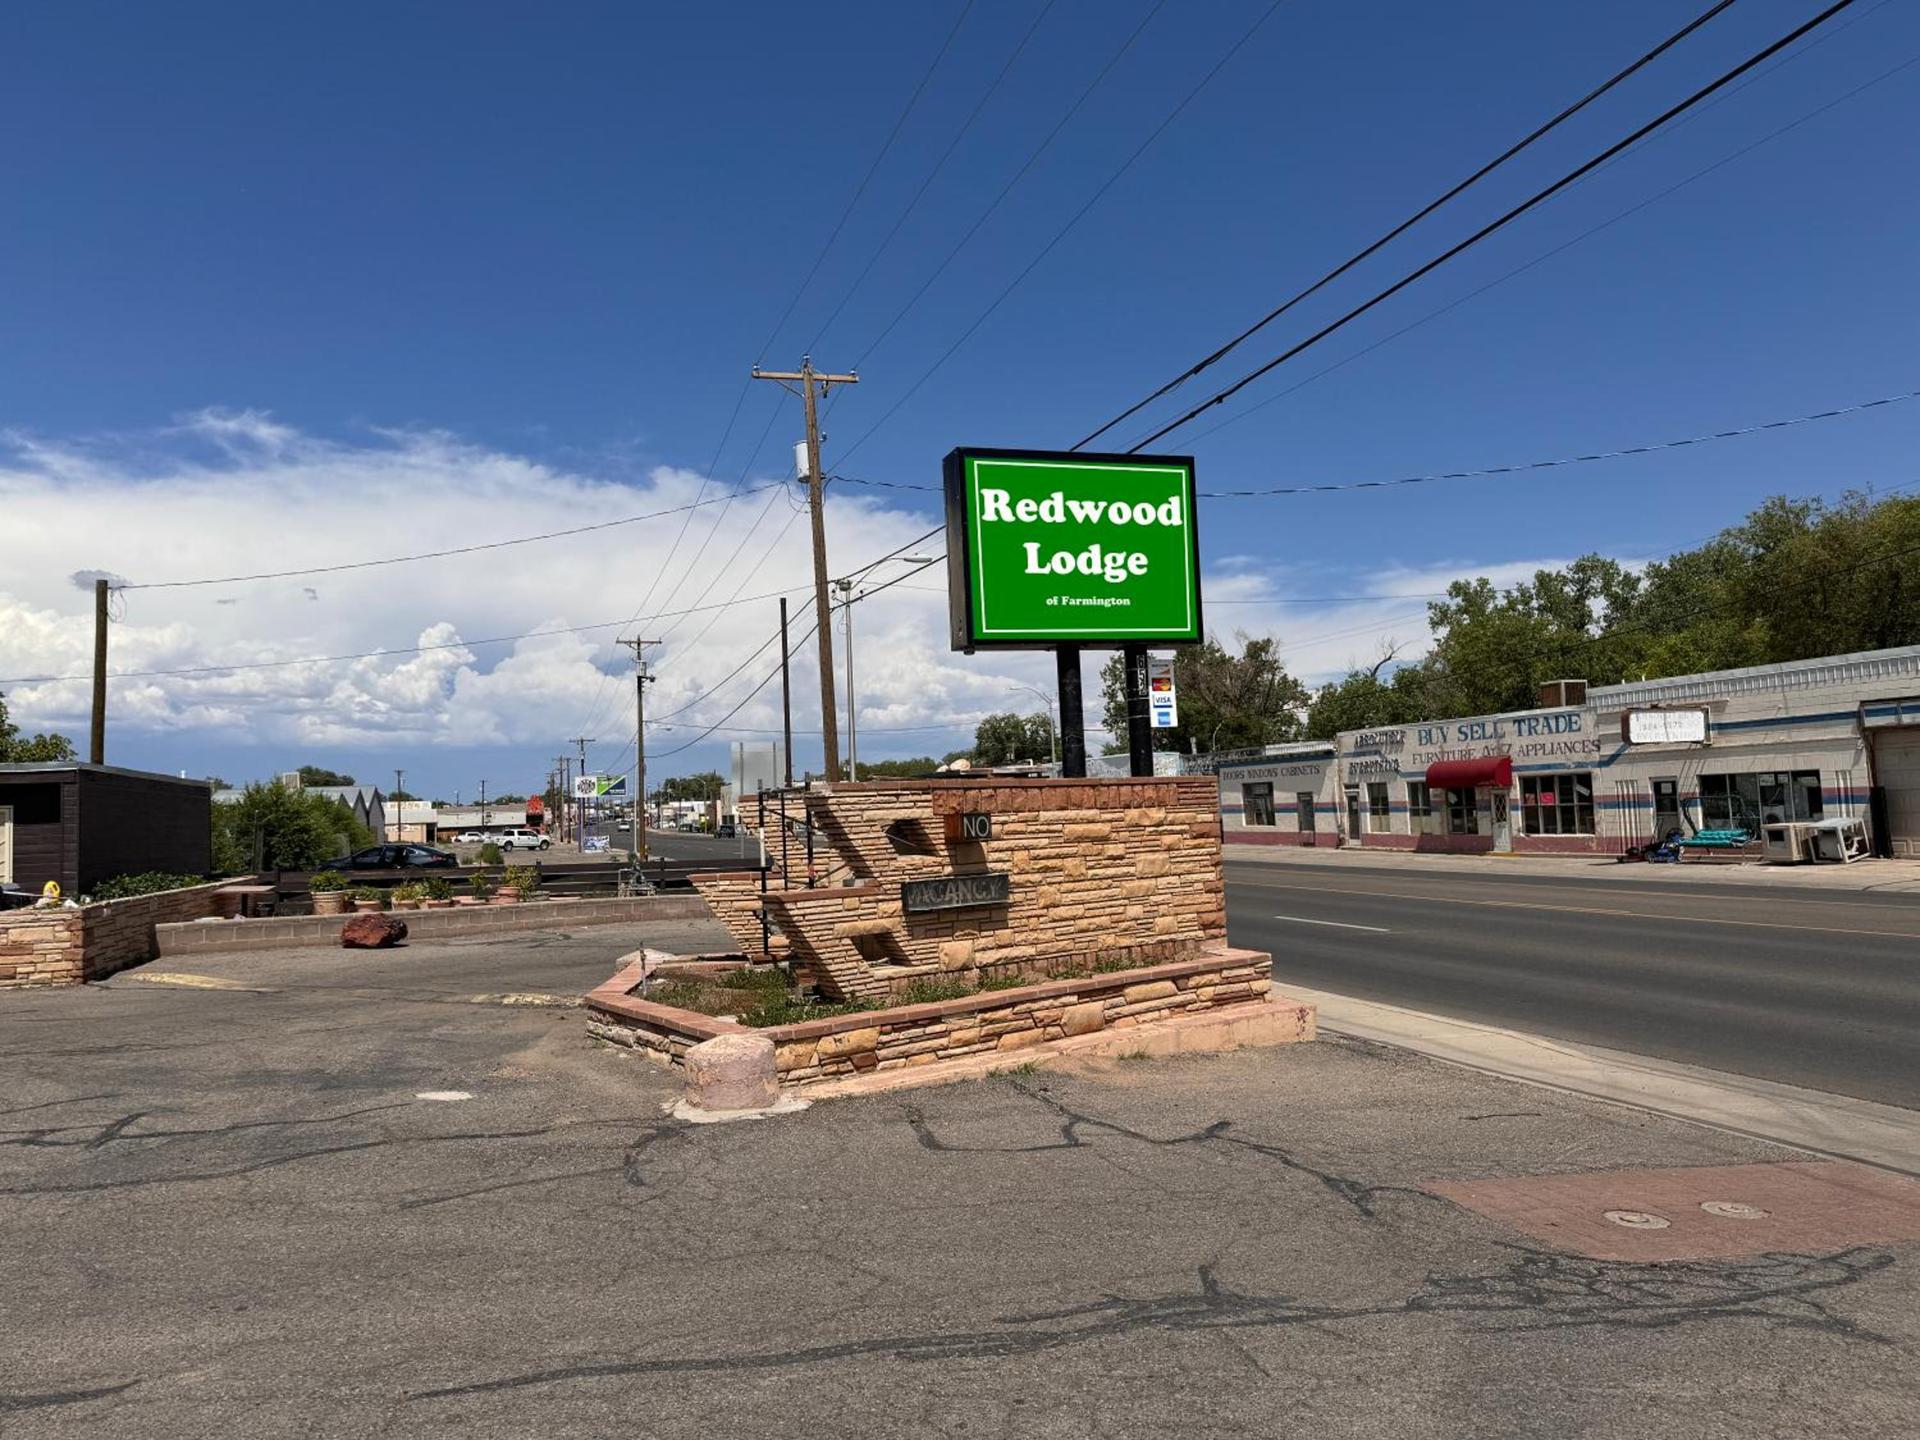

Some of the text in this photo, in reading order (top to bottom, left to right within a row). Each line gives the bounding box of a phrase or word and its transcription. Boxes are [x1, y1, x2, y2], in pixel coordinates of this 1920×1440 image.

[980, 488, 1183, 526] Redwood
[1022, 542, 1149, 583] Lodge
[1046, 596, 1131, 607] of Farmington
[1417, 713, 1582, 746] BUY SELL TRADE
[1412, 747, 1476, 765] FURNITURE
[1517, 740, 1601, 757] APPLIANCES
[1280, 764, 1321, 777] CABINETS
[963, 816, 989, 838] NO
[906, 880, 1000, 905] VACANCY
